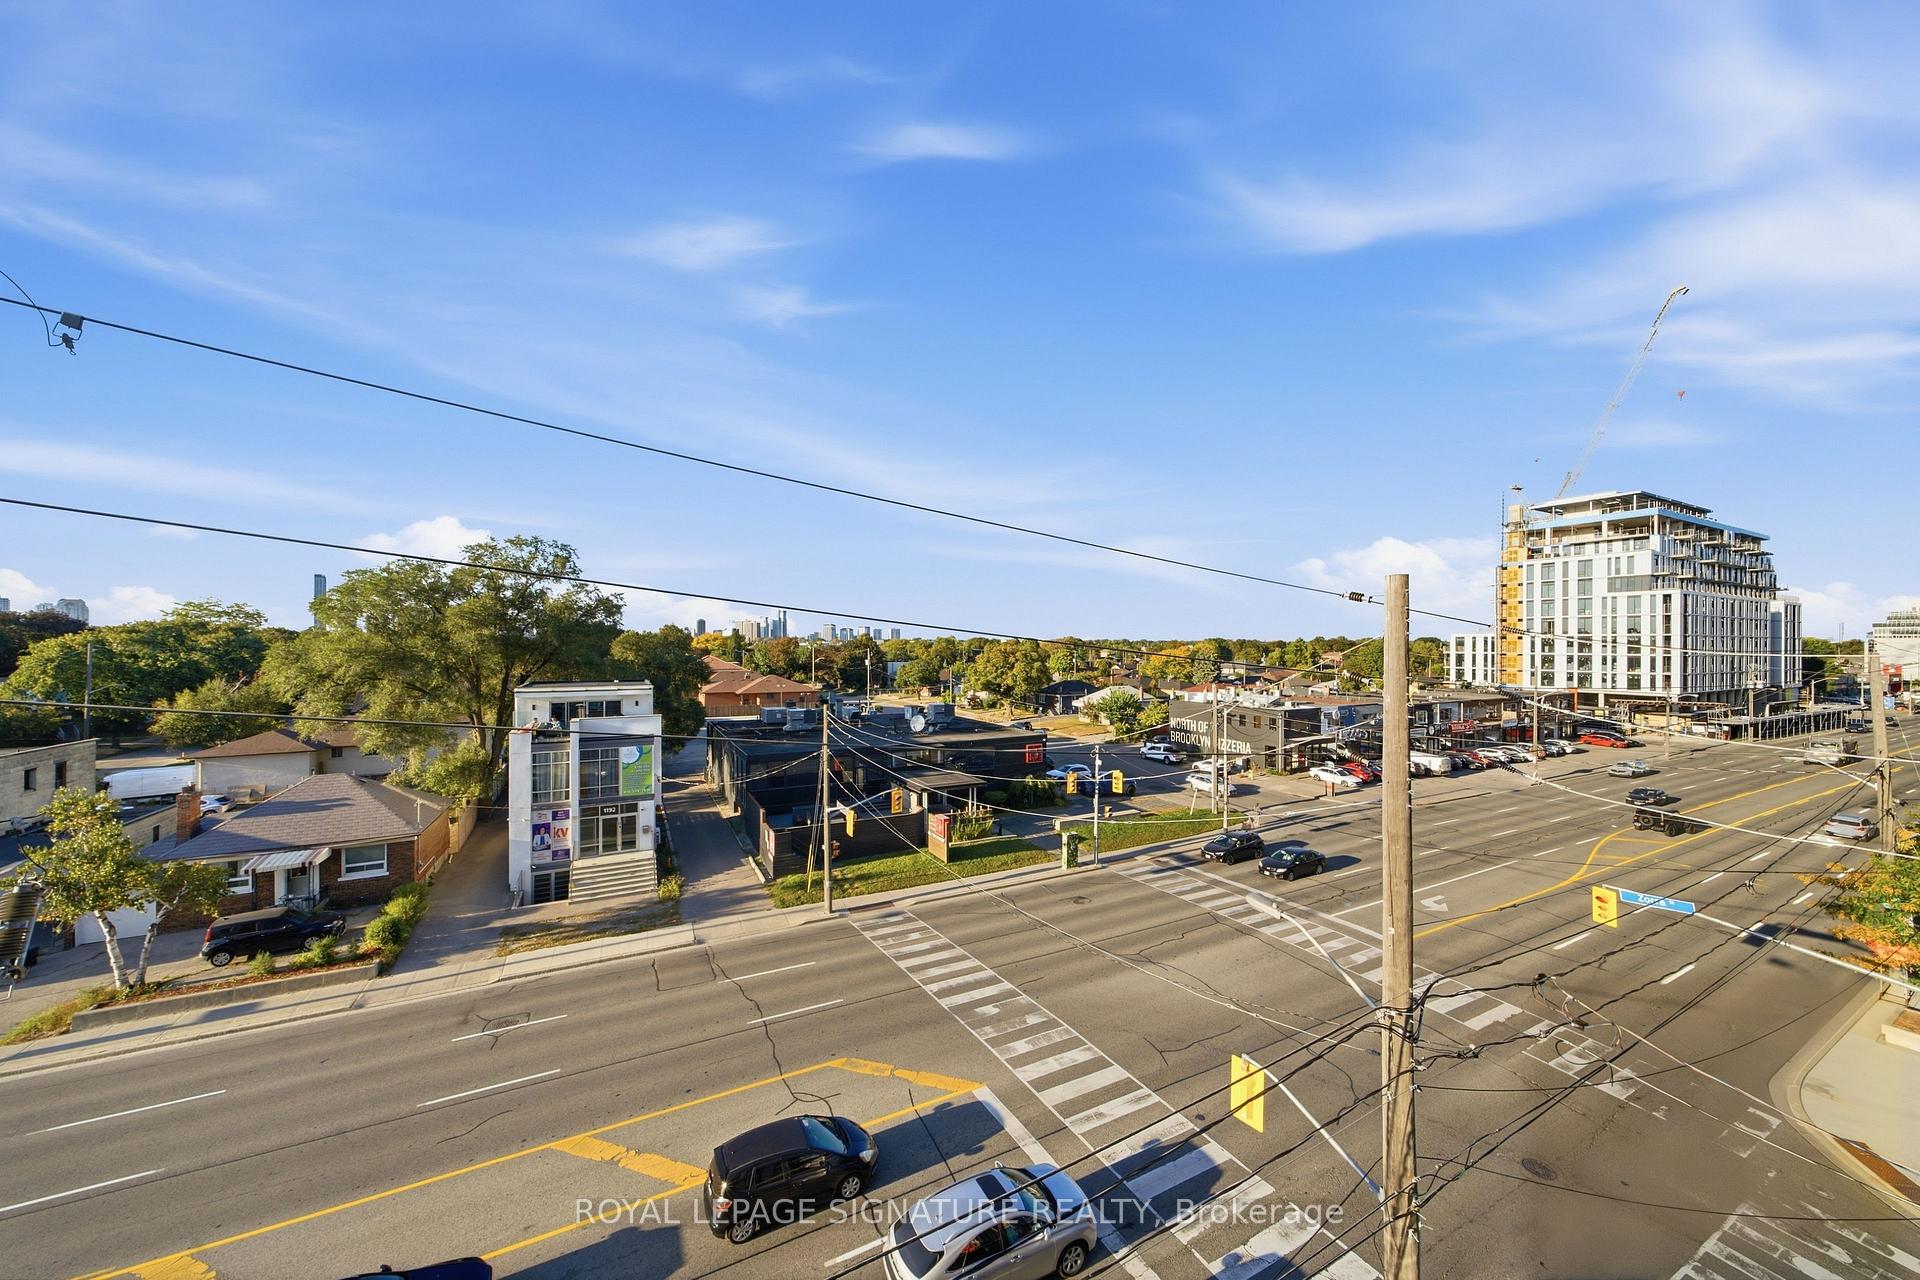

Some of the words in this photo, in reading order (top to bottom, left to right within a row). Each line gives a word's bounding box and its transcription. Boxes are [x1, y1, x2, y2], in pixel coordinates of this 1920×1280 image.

[1170, 717, 1196, 732] NORTH
[1198, 720, 1209, 733] OF
[1170, 730, 1211, 748] BROOKLYN
[1217, 737, 1252, 754] IZZERIA
[603, 806, 616, 814] 1192
